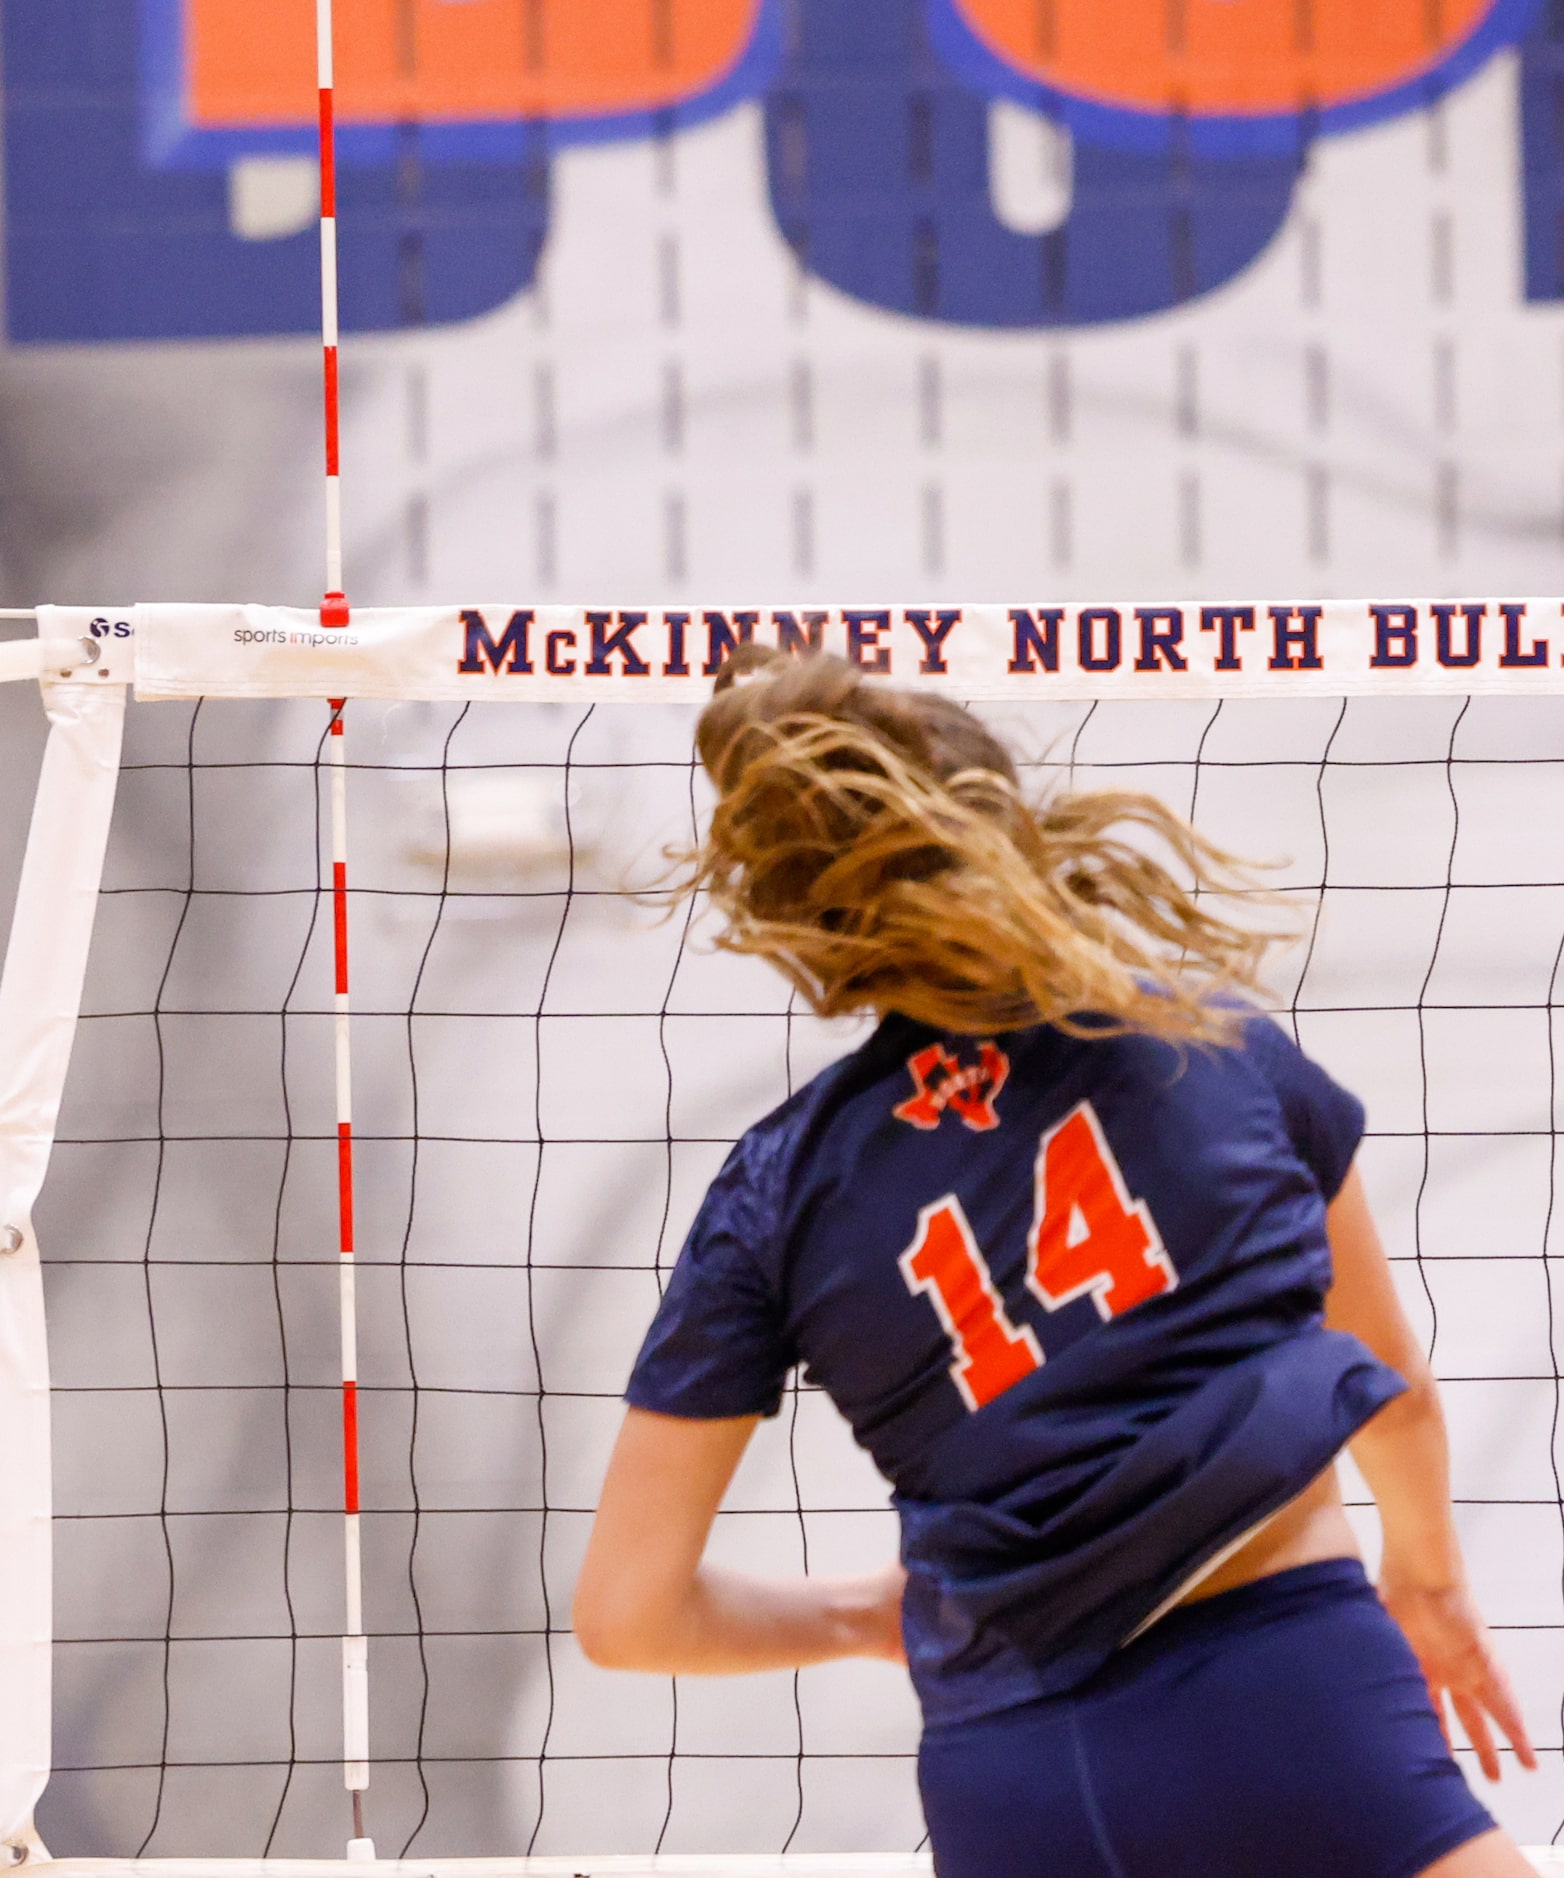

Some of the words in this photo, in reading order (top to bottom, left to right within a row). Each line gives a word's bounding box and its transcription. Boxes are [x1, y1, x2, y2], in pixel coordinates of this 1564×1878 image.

[113, 621, 135, 638] S
[234, 629, 286, 646] sports
[290, 632, 359, 647] imports
[1008, 605, 1324, 672] NORTH
[897, 1099, 1180, 1414] 14
